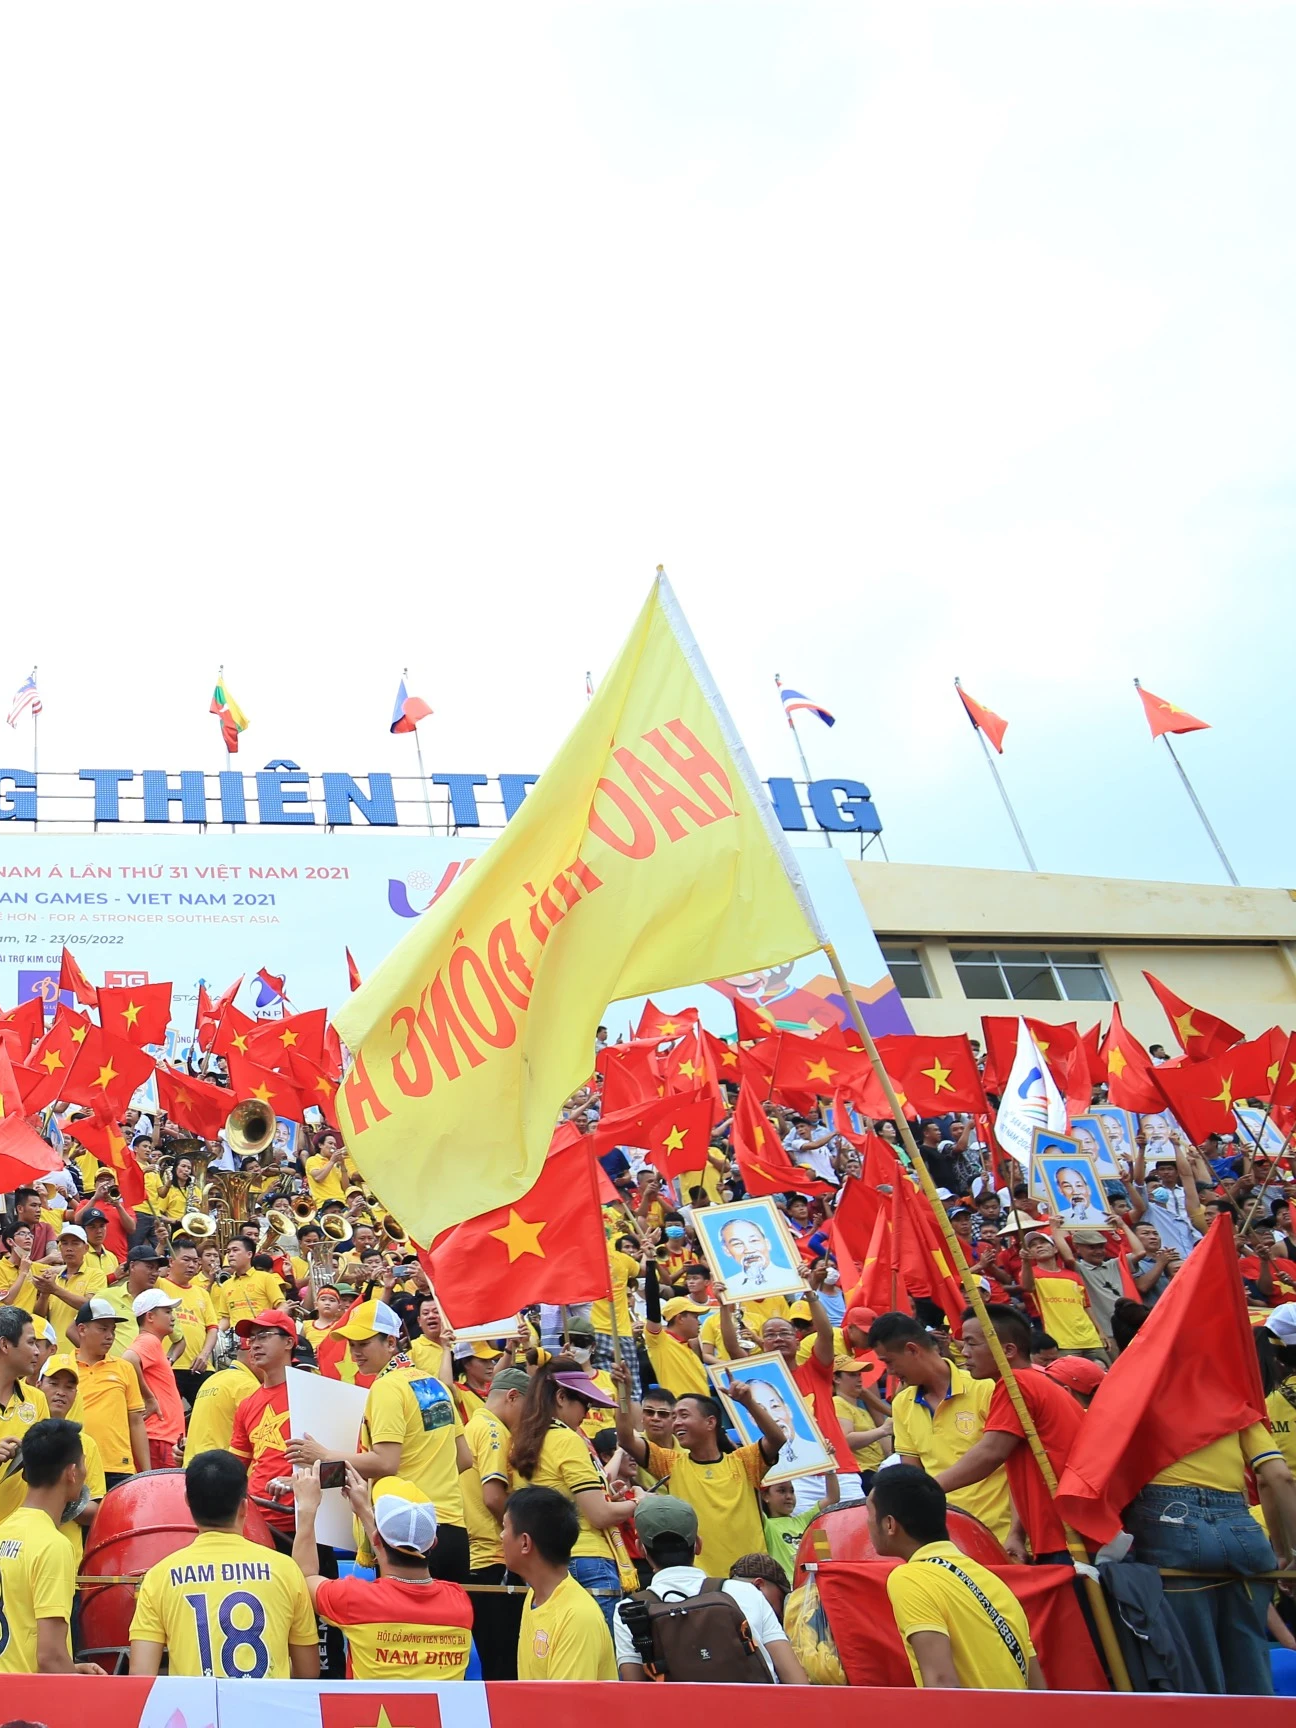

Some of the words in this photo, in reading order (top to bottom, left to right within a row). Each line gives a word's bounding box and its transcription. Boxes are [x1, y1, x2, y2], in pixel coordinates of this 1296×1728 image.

[79, 758, 399, 826] THIÊN
[48, 863, 63, 879] Á
[69, 862, 112, 879] LẦN
[118, 863, 164, 879] THỨ
[169, 866, 189, 879] 31
[194, 863, 242, 882] VIỆT
[248, 866, 298, 879] NAM
[304, 866, 350, 880] 2021
[34, 892, 109, 905] GAMES
[126, 892, 173, 905] VIET
[178, 893, 227, 906] NAM
[232, 893, 276, 906] 2021
[49, 913, 76, 922] FOR
[79, 914, 89, 922] A
[92, 914, 165, 923] STRONGER
[166, 914, 246, 924] SOUTHEAST
[249, 915, 280, 924] ASIA
[24, 934, 38, 944] 12
[49, 933, 125, 946] 23/05/2022
[27, 955, 44, 963] KIM
[1270, 1420, 1291, 1434] AM
[170, 1564, 215, 1587] NAM
[221, 1562, 271, 1585] ĐỊNH
[184, 1589, 270, 1679] 18
[375, 1647, 419, 1666] NAM
[423, 1651, 464, 1670] ĐỊNH
